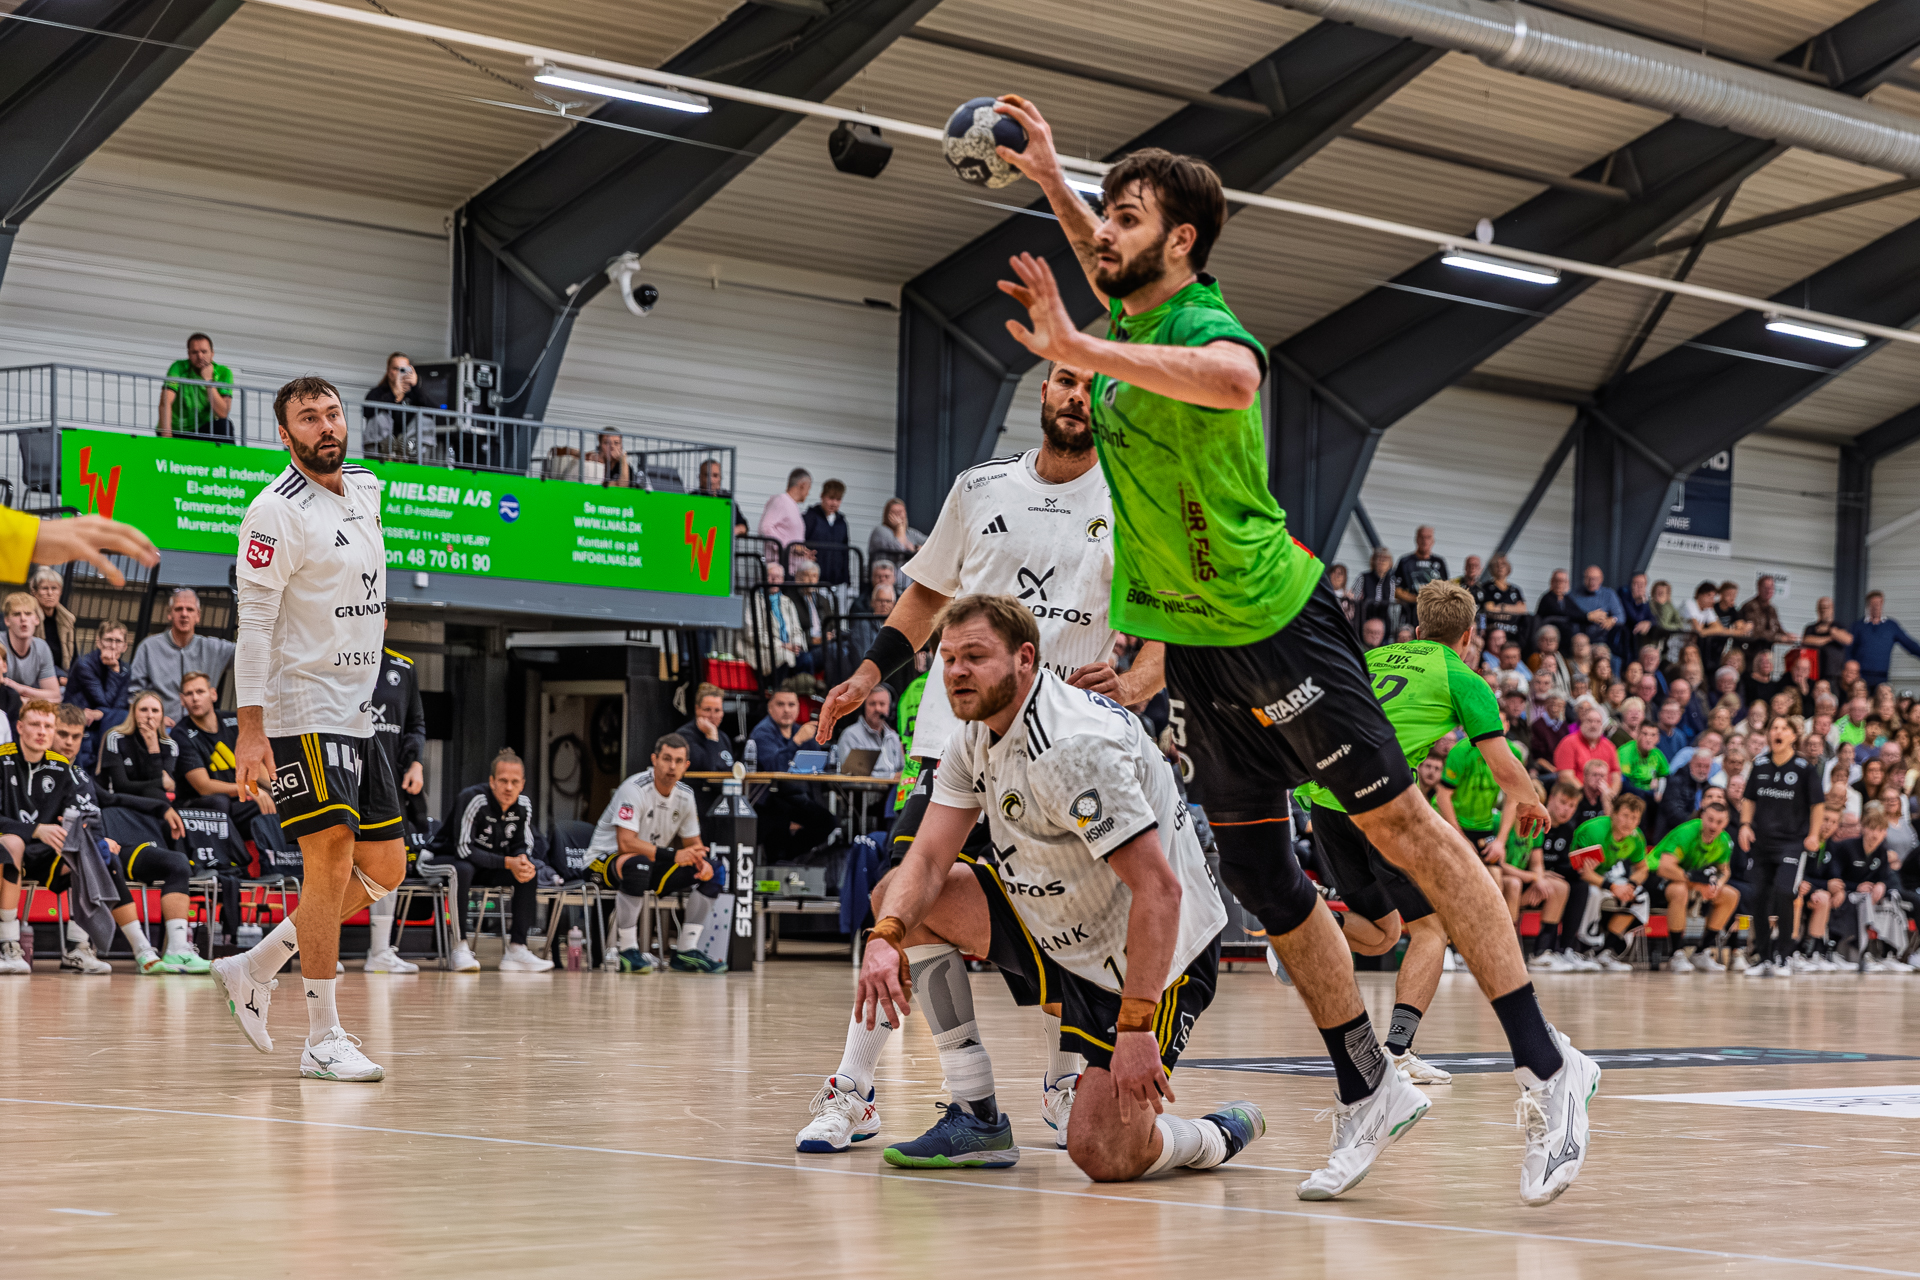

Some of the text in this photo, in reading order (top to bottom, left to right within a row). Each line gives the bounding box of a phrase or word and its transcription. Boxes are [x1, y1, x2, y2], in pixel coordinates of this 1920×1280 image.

[156, 459, 168, 473] Vi
[170, 461, 210, 478] leverer
[212, 465, 227, 479] alt
[972, 472, 1007, 485] LARS LARSEN
[186, 481, 246, 500] El-arbejde
[389, 481, 460, 505] NIELSEN
[463, 489, 492, 508] A/S
[583, 502, 634, 519] Se mere på
[1027, 506, 1071, 515] GRUNDFOS
[250, 530, 277, 546] SPORT
[422, 530, 432, 541] 11
[577, 535, 639, 553] Kontakt os på
[249, 545, 270, 564] 24
[406, 548, 426, 566] 48
[429, 550, 447, 568] 70
[450, 552, 467, 570] 61
[472, 553, 491, 572] 90
[334, 651, 376, 666] JYSKE
[1386, 654, 1412, 664] VVS
[1264, 676, 1322, 721] STARK
[1316, 749, 1343, 770] CRAFT
[1355, 779, 1382, 798] CRAFT
[1083, 817, 1115, 844] HSHOP
[735, 843, 754, 937] SELECT
